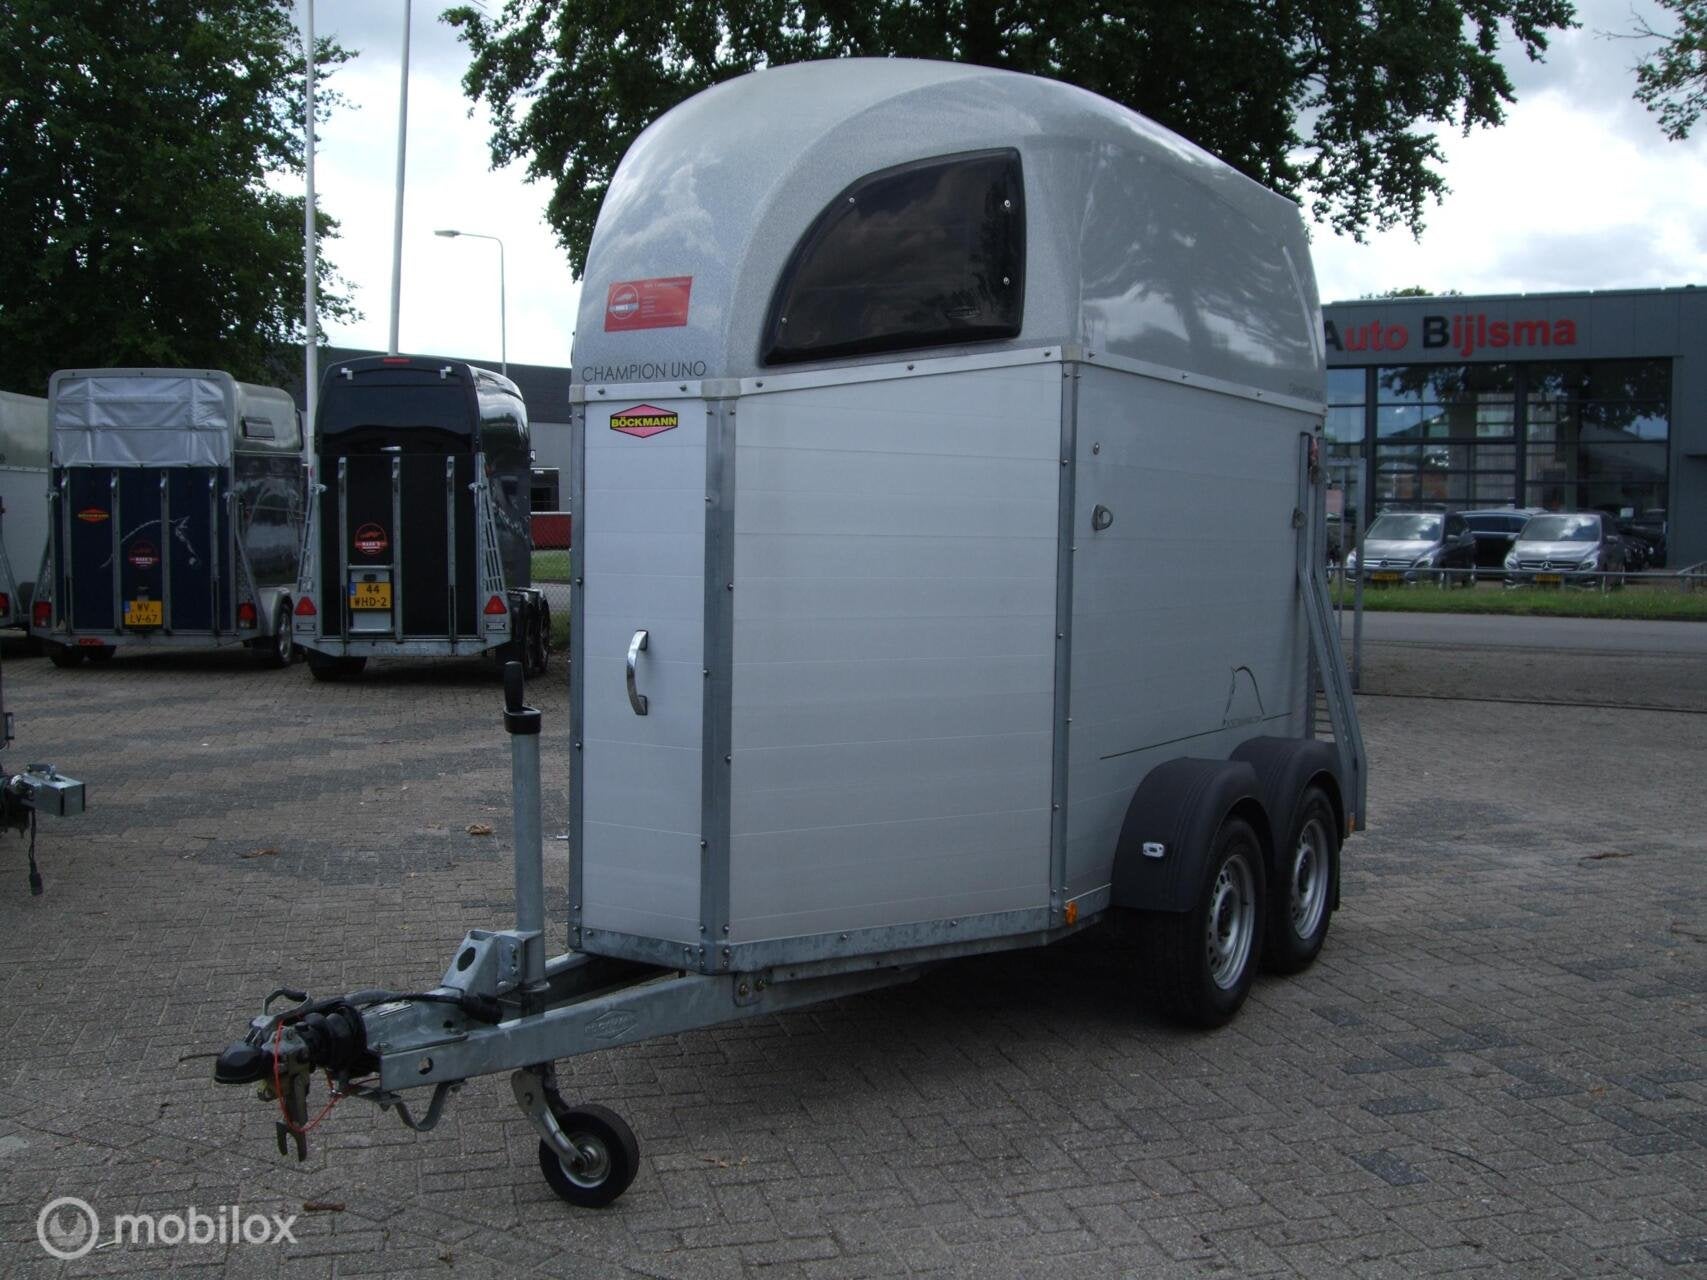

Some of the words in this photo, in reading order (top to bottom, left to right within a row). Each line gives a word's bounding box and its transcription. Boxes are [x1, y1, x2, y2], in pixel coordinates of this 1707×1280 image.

[1324, 319, 1408, 351] Auto
[1422, 314, 1577, 358] Bijlsma
[582, 362, 666, 382] CHAMPION
[671, 360, 706, 378] UNO
[611, 417, 677, 427] BÖCKMANN
[366, 584, 380, 594] 44
[354, 596, 387, 607] WHD-2
[130, 613, 158, 624] LV-67
